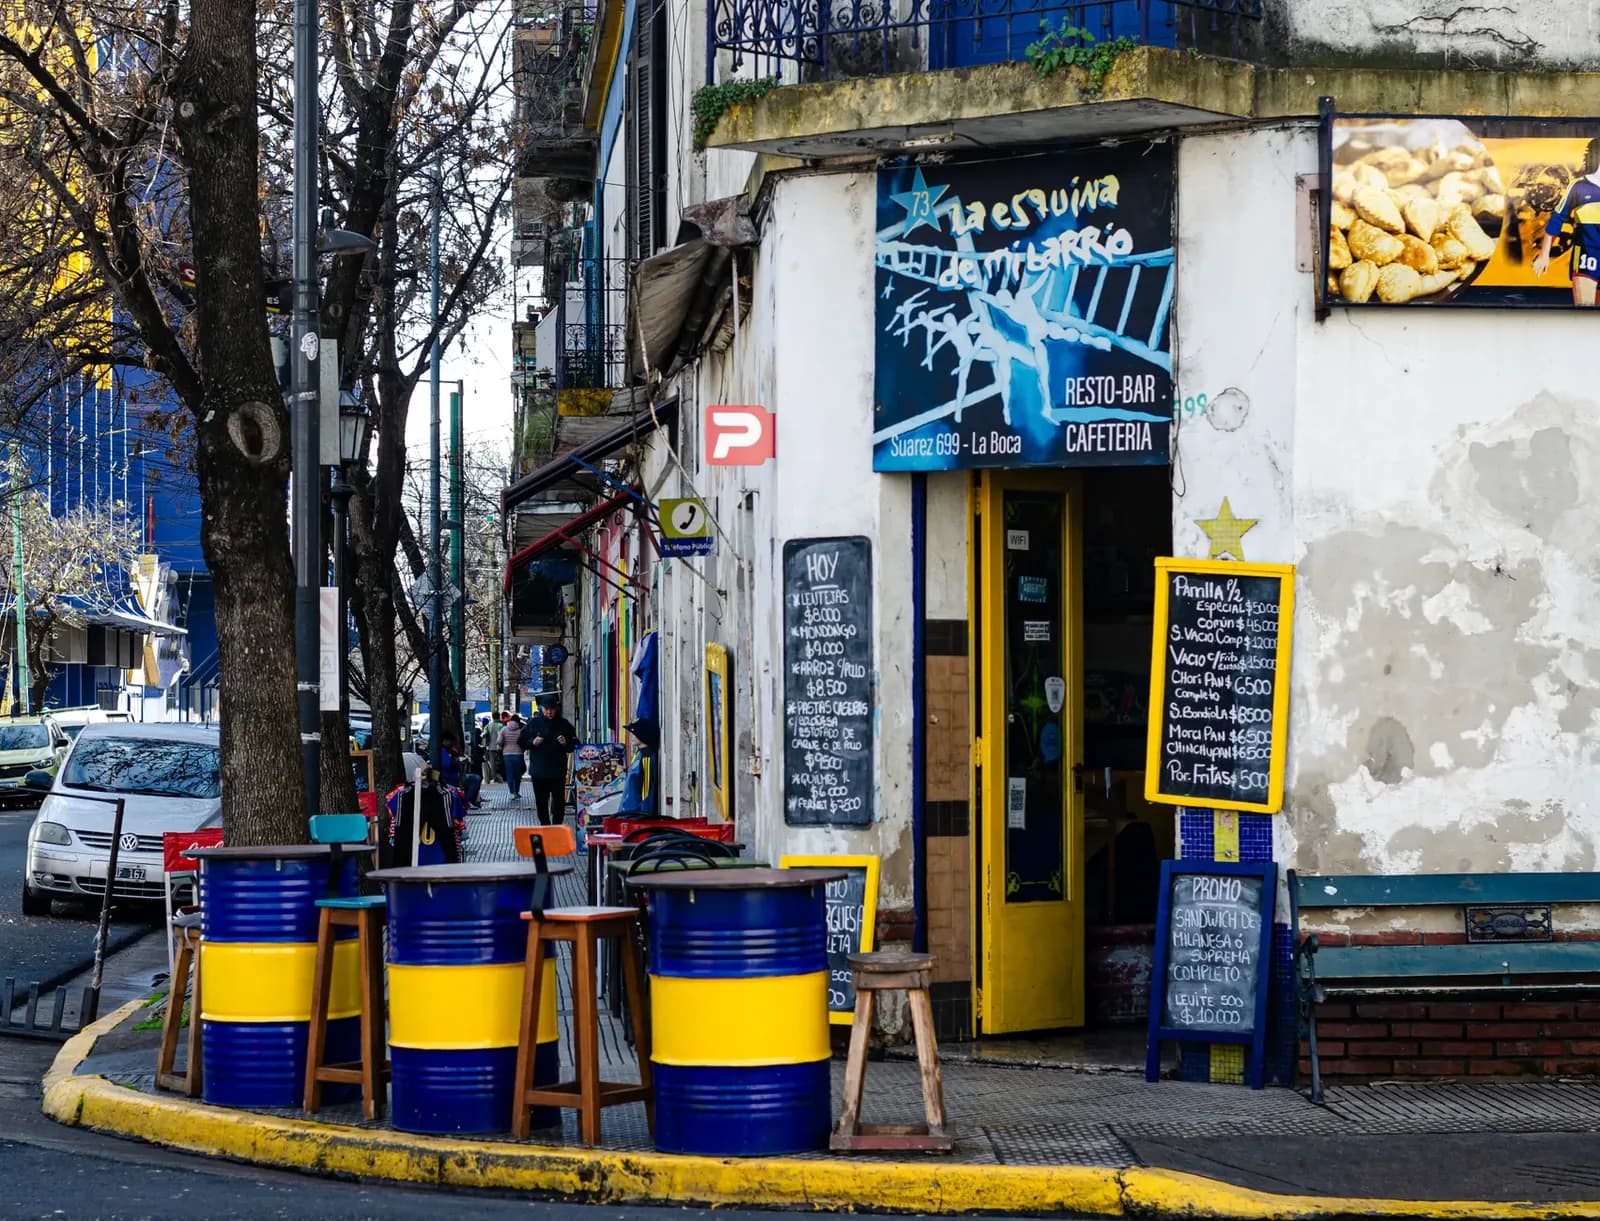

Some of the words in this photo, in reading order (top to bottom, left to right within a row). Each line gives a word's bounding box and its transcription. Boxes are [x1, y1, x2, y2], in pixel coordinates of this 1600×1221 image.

[912, 191, 929, 217] 73
[938, 252, 978, 290] de
[983, 240, 1020, 284] mi
[1579, 254, 1597, 272] 10
[1065, 374, 1155, 406] RESTO-BAR
[890, 434, 933, 458] Suarez
[936, 433, 960, 456] 699
[972, 433, 987, 455] La
[990, 432, 1021, 455] Boca
[1065, 422, 1152, 453] CAFETERIA
[1010, 535, 1026, 545] WIFI
[807, 552, 839, 582] HOY
[800, 623, 856, 639] MONDONGO
[801, 659, 835, 675] ARROZ
[798, 700, 832, 716] PASTAS
[833, 700, 868, 716] CASERAS
[842, 728, 855, 739] DE
[1192, 877, 1241, 901] PROMO
[1175, 909, 1237, 929] SANDWICH
[1241, 910, 1256, 929] DE
[1191, 949, 1250, 964] SUPREMA
[1173, 964, 1240, 981] COMPLETO
[1175, 992, 1214, 1006] LEVITE
